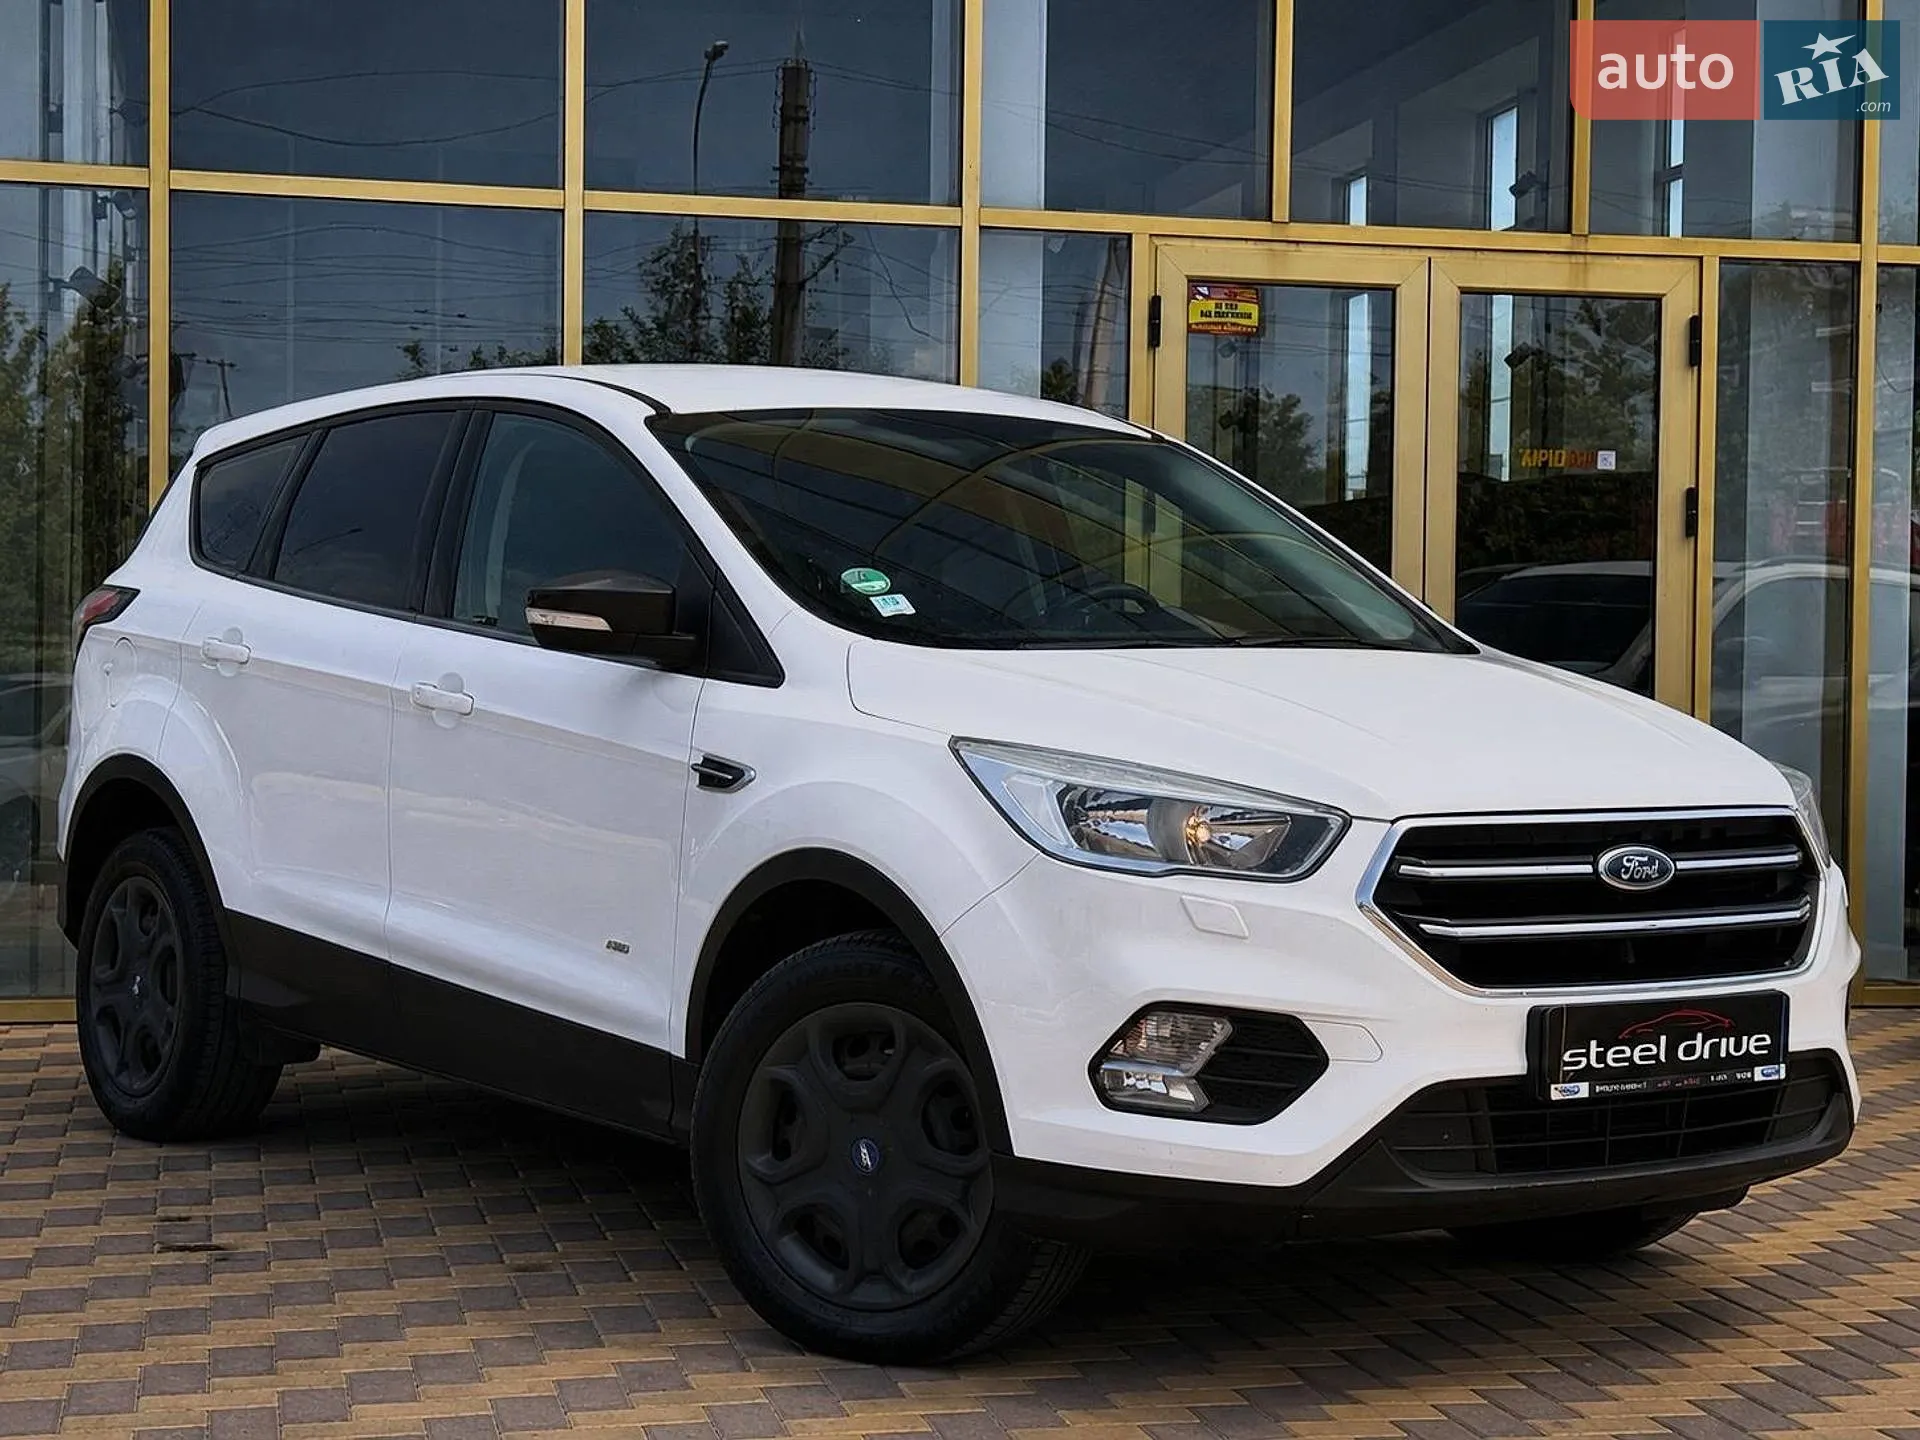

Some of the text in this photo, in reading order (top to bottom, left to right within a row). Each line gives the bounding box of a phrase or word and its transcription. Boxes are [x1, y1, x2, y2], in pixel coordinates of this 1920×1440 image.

[1621, 855, 1659, 880] Ford
[1562, 1032, 1772, 1071] steel drive
